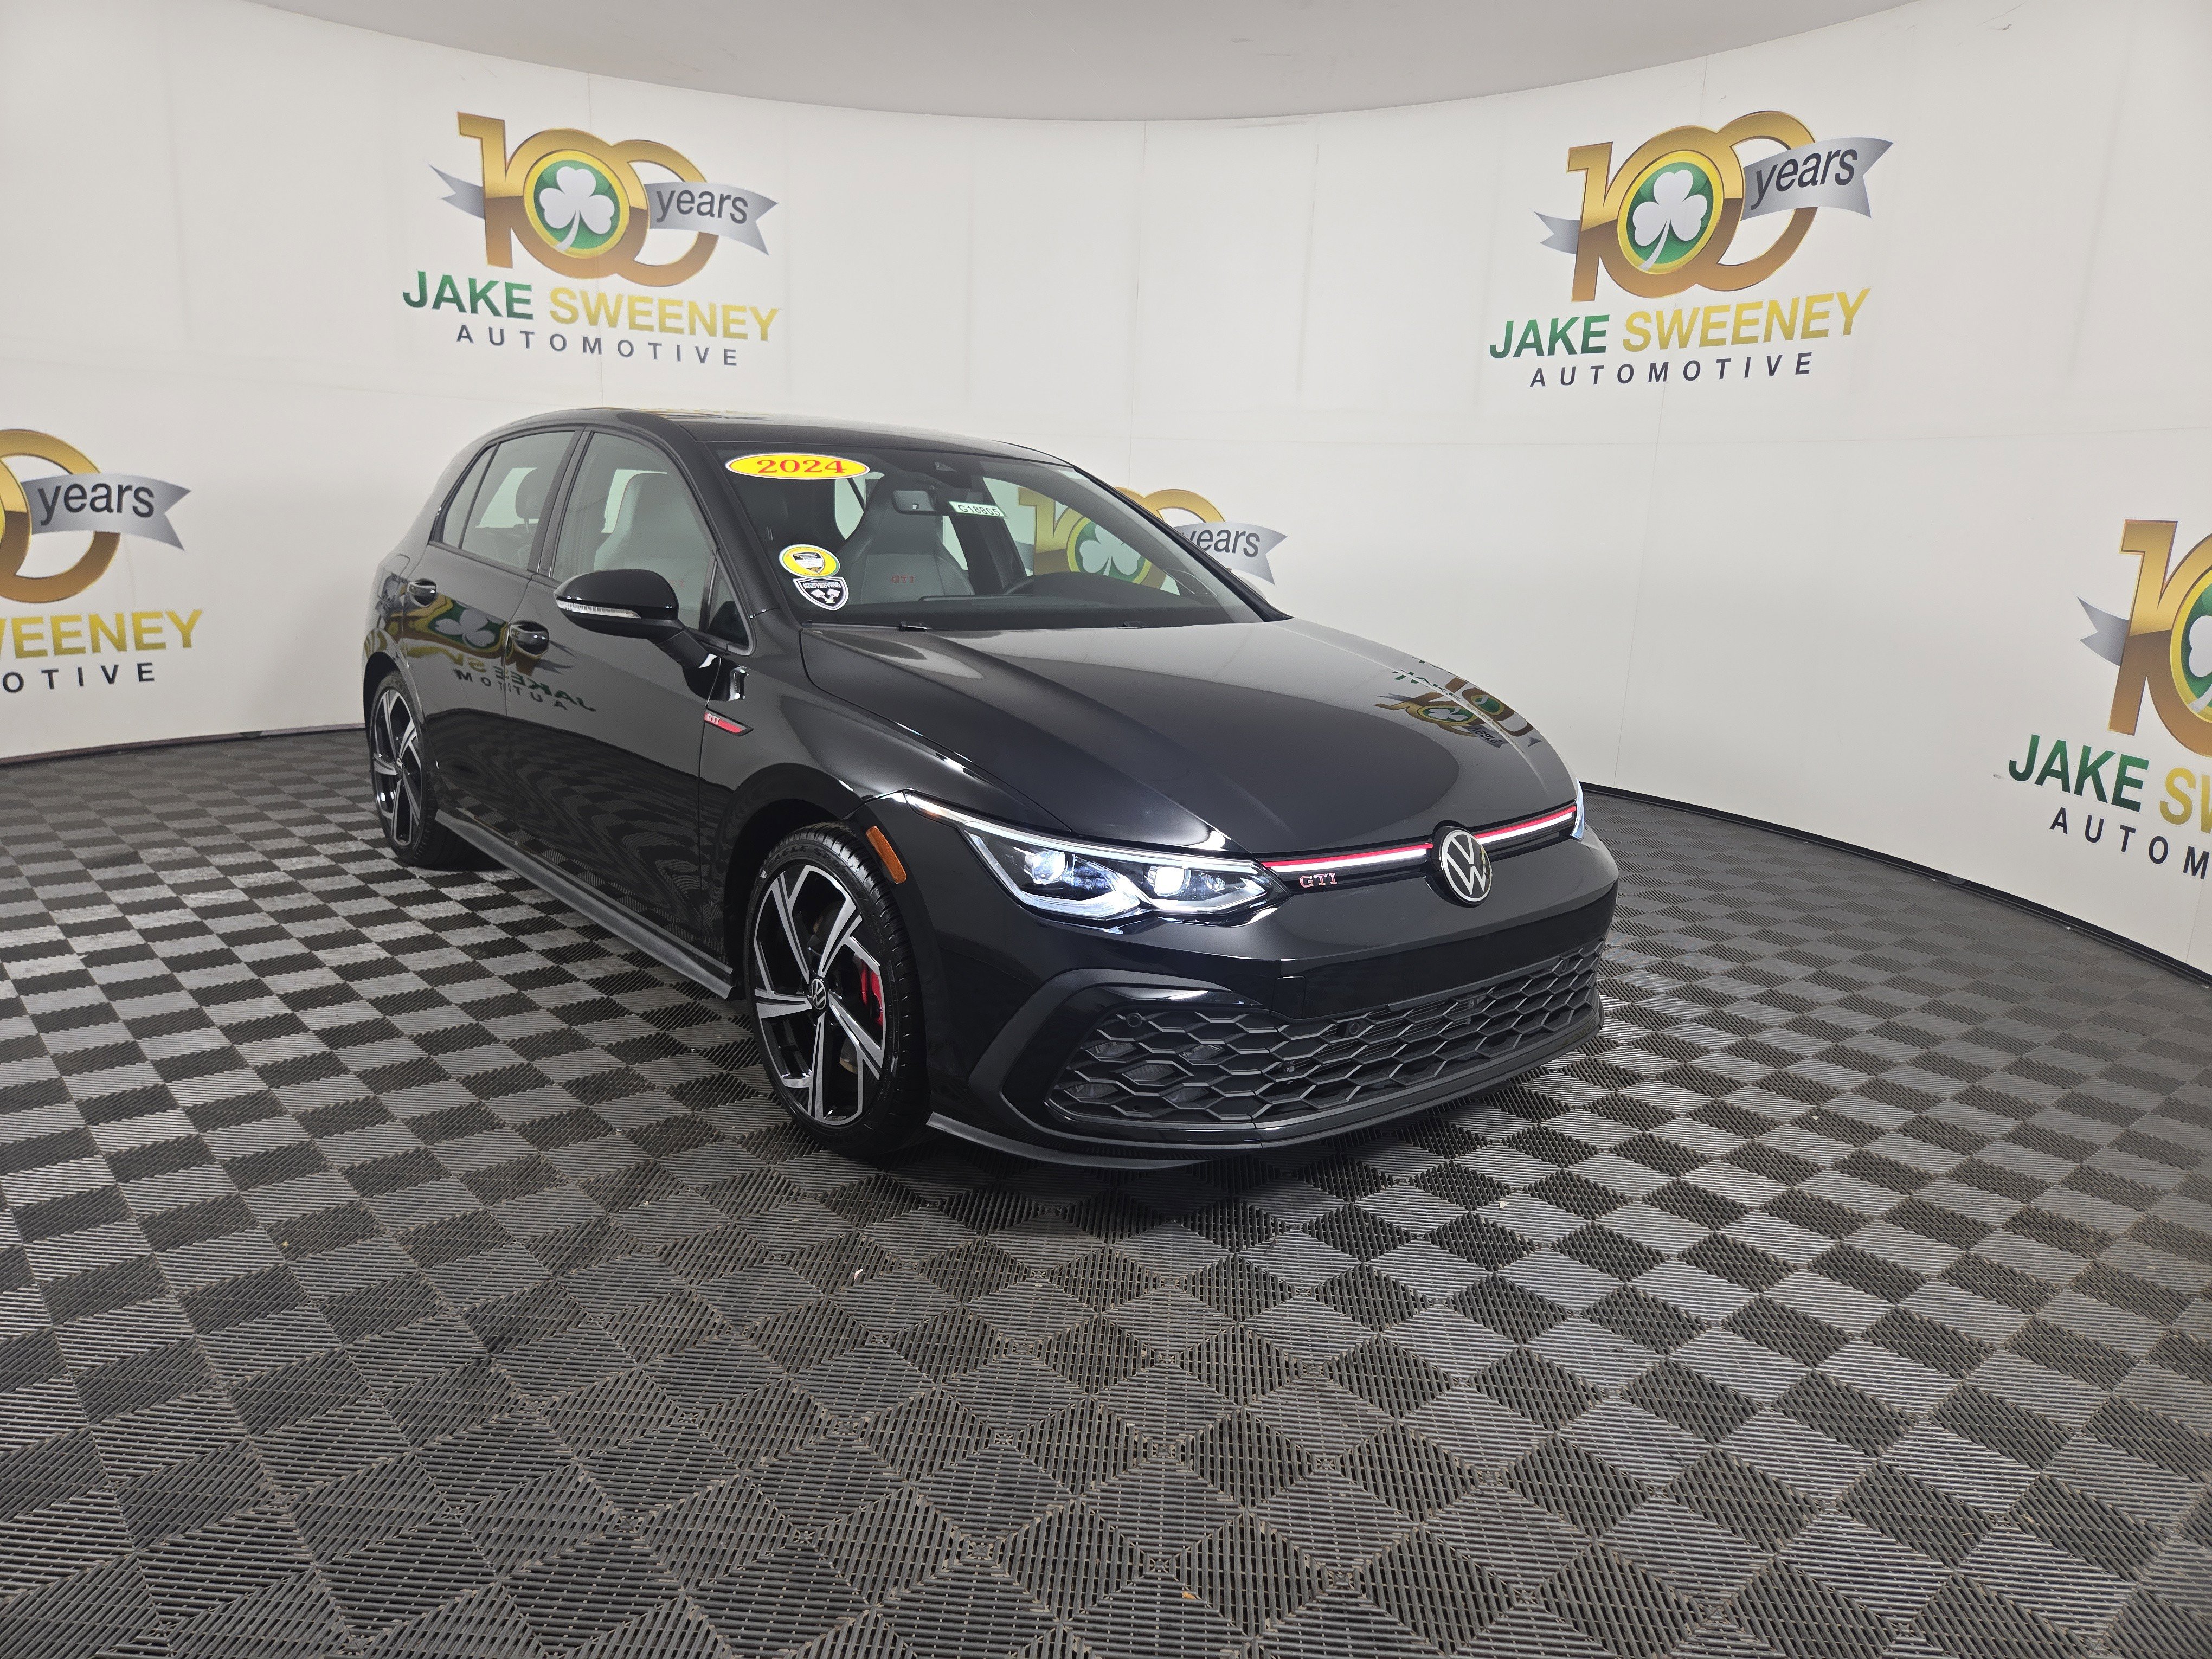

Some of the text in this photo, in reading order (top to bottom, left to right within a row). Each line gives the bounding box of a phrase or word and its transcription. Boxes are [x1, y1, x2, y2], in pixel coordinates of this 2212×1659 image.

[1750, 146, 1859, 210] years
[656, 189, 749, 224] years
[402, 271, 780, 342] JAKE SWEENEY
[1489, 287, 1871, 359] JAKE SWEENEY
[456, 324, 738, 366] AUTOMOTIVE
[1530, 351, 1812, 387] AUTOMOTIVE
[757, 459, 847, 473] 2024
[37, 483, 156, 526] years
[957, 505, 1001, 516] G18865
[891, 575, 915, 583] GTI
[0, 609, 203, 659] EENEY
[2, 663, 155, 693] OTIVE
[706, 713, 721, 725] GTI
[2008, 734, 2150, 813] JAKE
[2049, 807, 2210, 880] AUTOM
[1299, 872, 1338, 888] GTI
